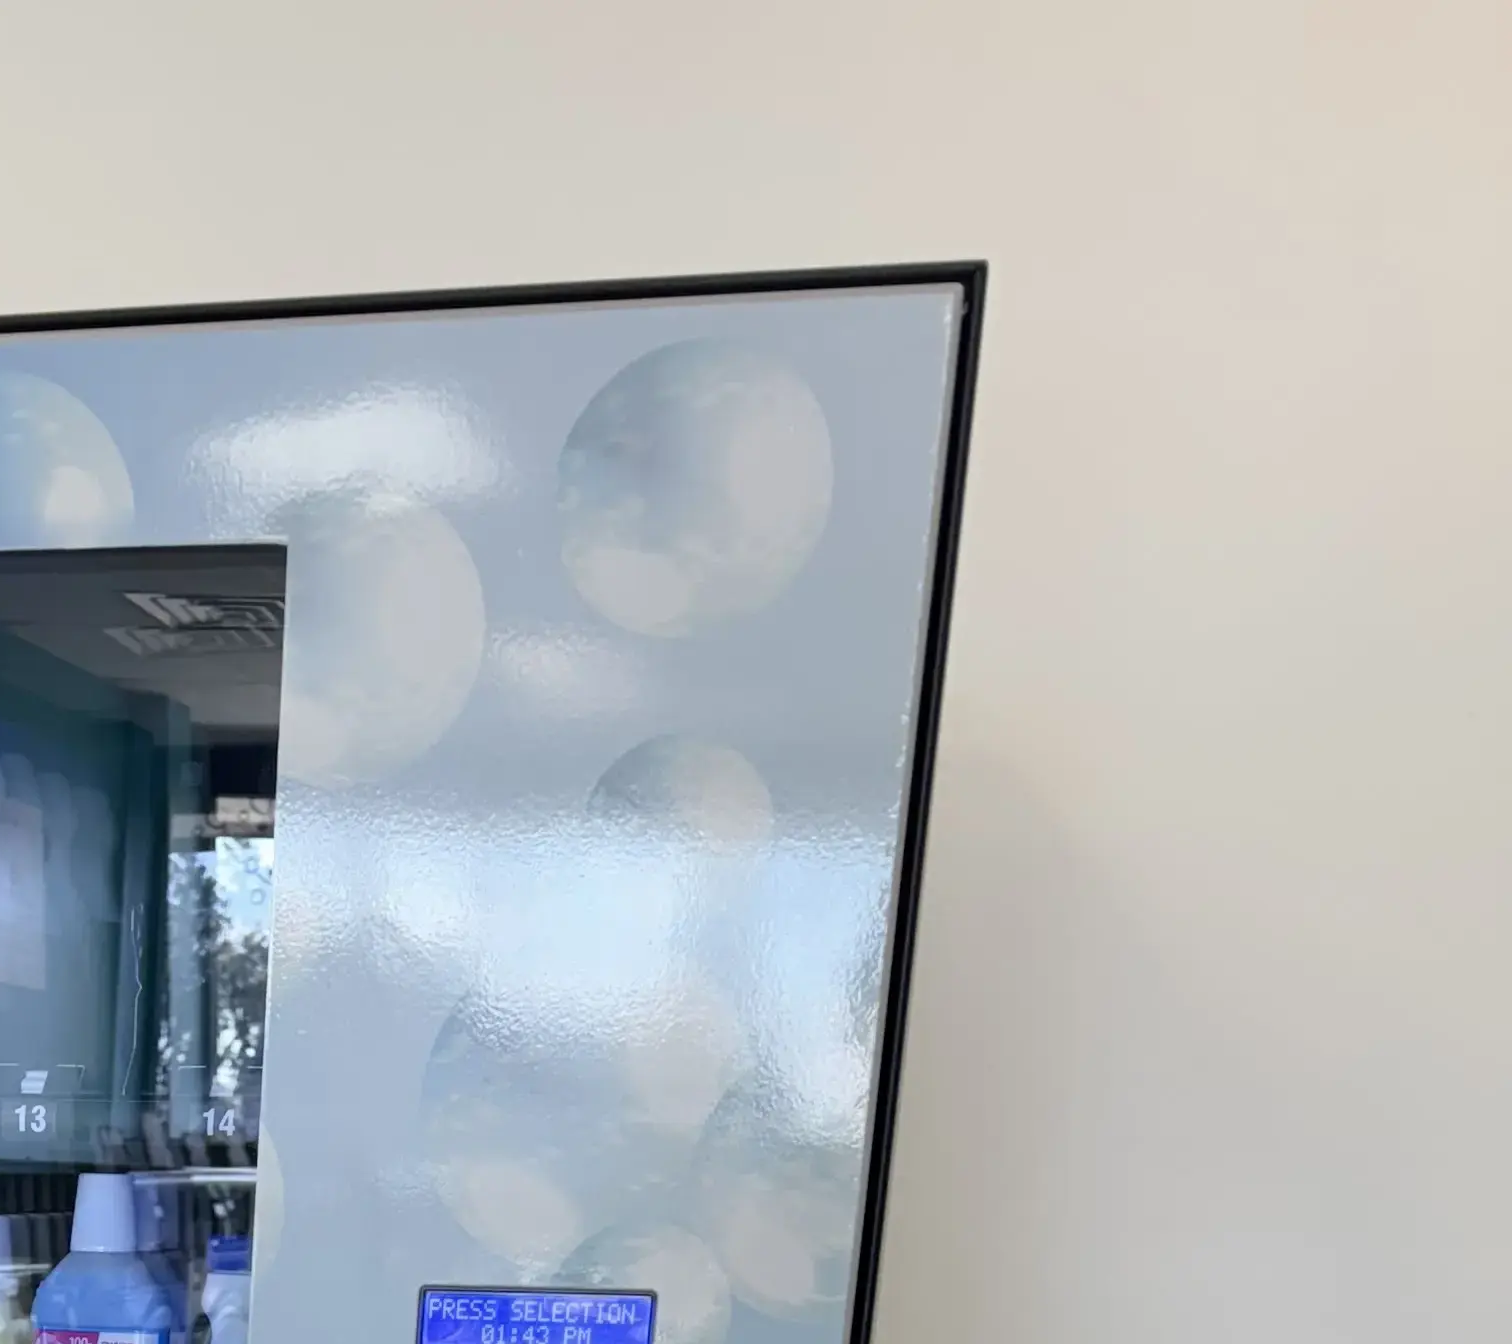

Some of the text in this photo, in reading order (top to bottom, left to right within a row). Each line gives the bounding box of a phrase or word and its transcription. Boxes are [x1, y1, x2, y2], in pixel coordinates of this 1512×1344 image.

[14, 1105, 47, 1133] 13
[203, 1109, 236, 1136] 14
[429, 1298, 636, 1325] PRESS SELECTION
